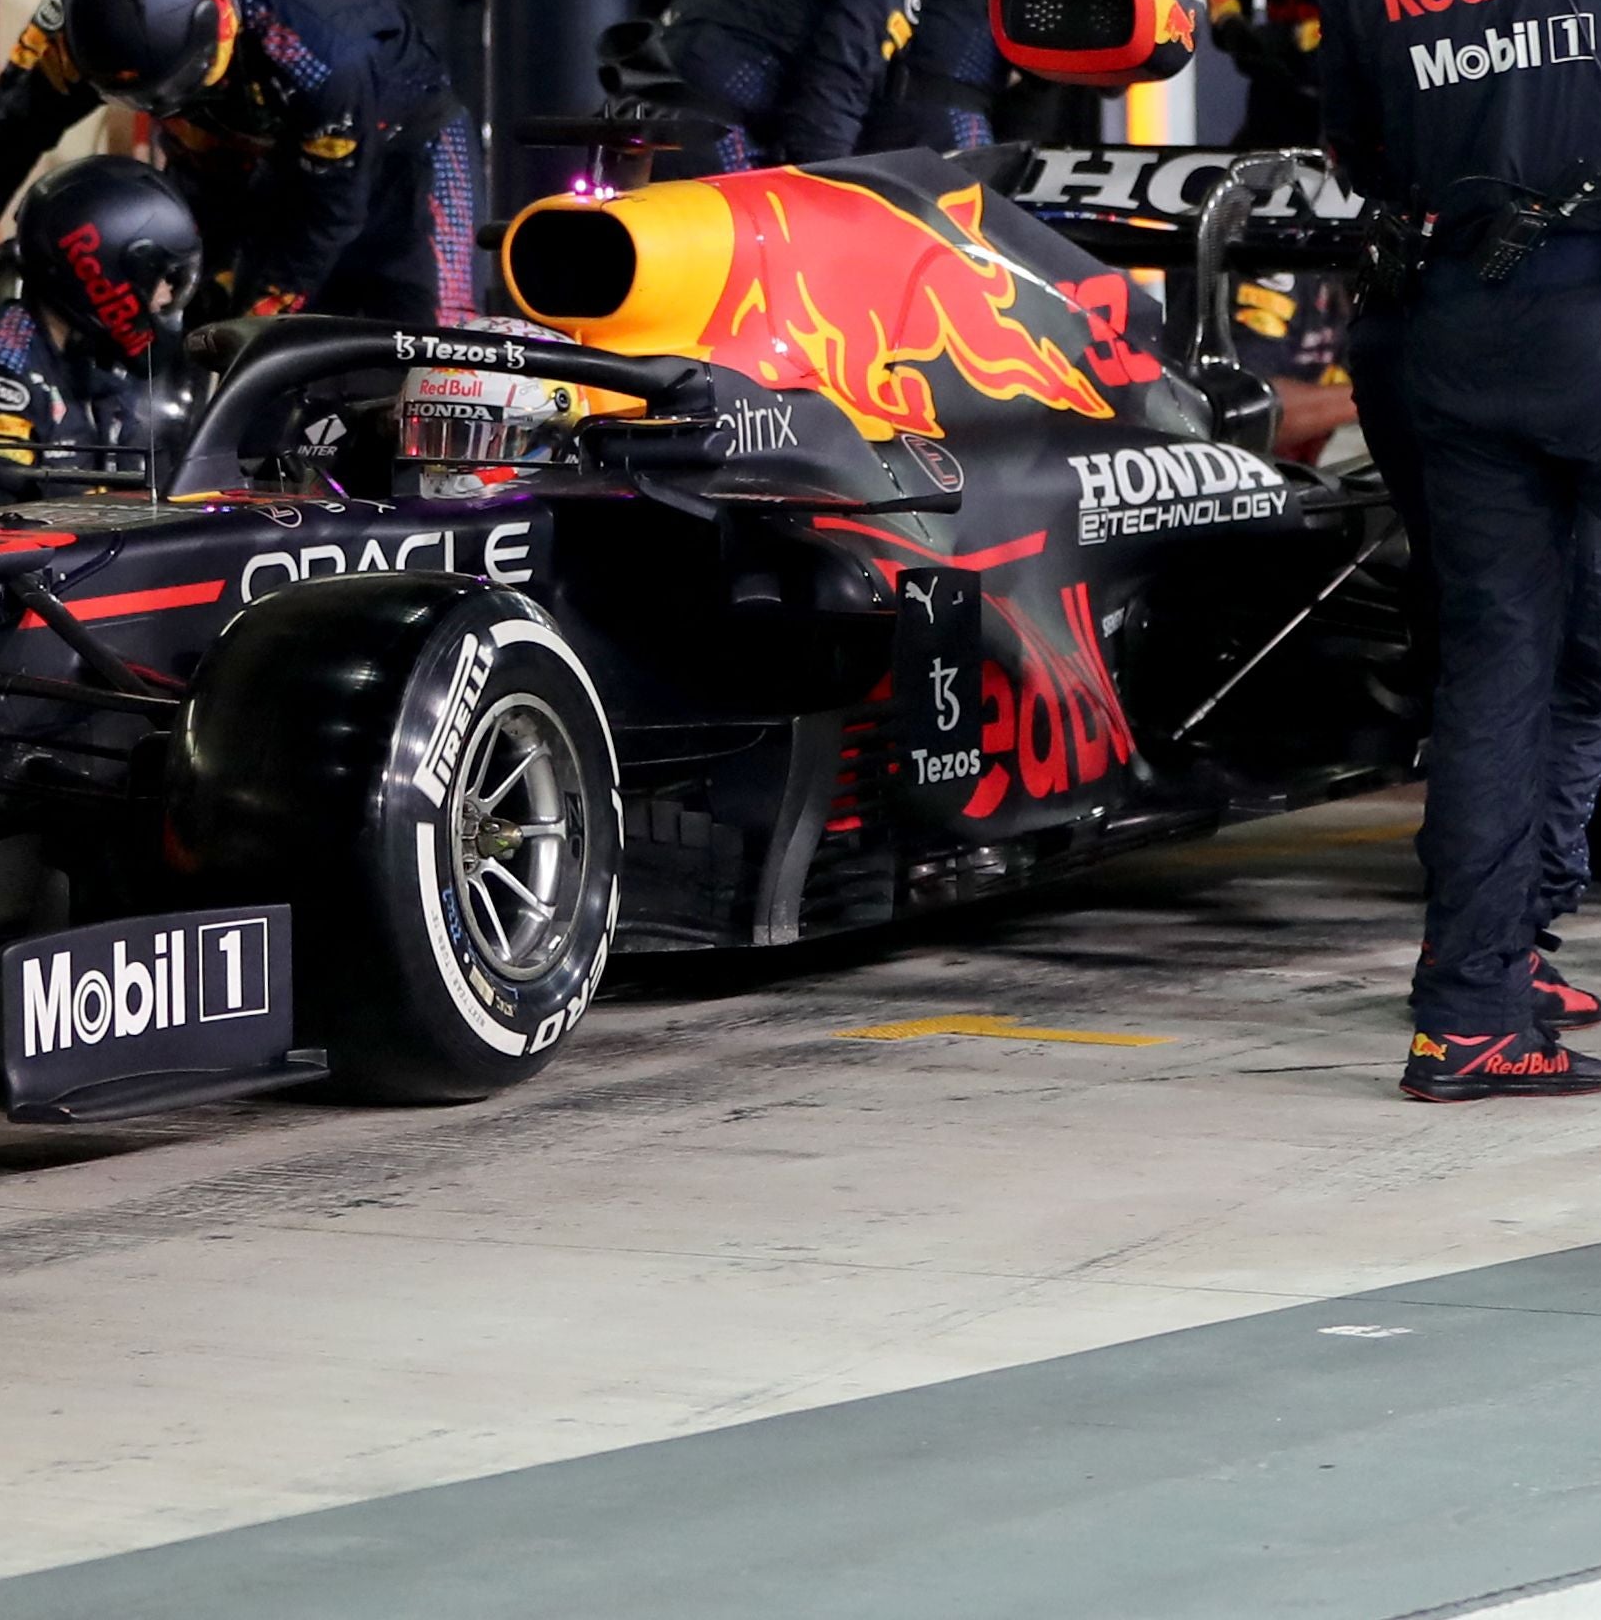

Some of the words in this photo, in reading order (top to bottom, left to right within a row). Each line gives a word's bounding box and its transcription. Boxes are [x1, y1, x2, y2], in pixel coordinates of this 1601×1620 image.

[1409, 20, 1543, 91] Mobil
[422, 336, 497, 364] Tezos
[419, 379, 448, 397] Red
[449, 380, 482, 398] Bull
[406, 402, 494, 422] HONDA
[297, 445, 339, 458] INTER
[1067, 442, 1285, 509] HONDA
[413, 632, 495, 810] PIRELLI
[911, 747, 982, 786] Tezos
[23, 930, 186, 1058] Mobil
[1484, 1052, 1530, 1075] Red
